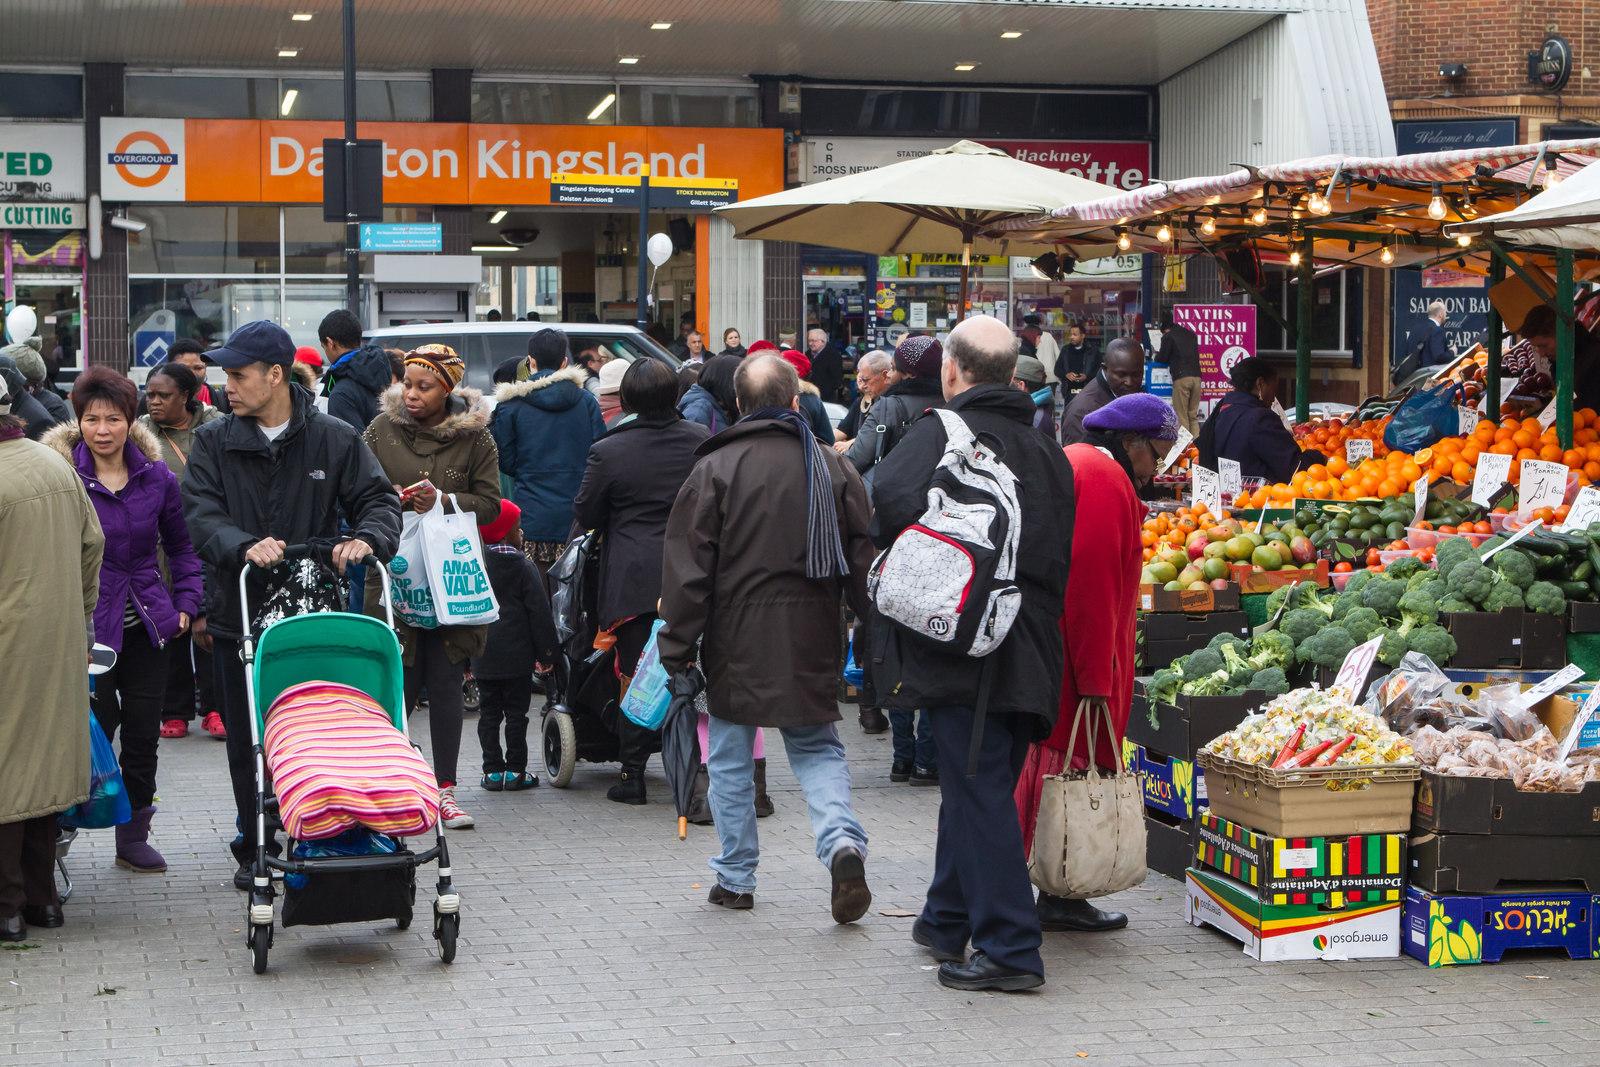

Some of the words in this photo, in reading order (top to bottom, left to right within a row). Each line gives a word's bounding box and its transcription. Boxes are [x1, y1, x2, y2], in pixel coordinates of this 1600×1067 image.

[1414, 130, 1460, 144] Welcome
[1463, 132, 1474, 143] to
[1475, 128, 1497, 143] all
[0, 152, 52, 176] ED
[113, 155, 173, 164] OVERGROUND
[270, 137, 459, 178] Daton
[478, 139, 706, 179] Kingsland
[1016, 149, 1092, 165] Hackney
[5, 206, 72, 225] CUTTING
[1409, 297, 1466, 313] SALON
[1177, 309, 1233, 320] MATHS
[1197, 334, 1244, 346] IENCE
[1231, 843, 1259, 865] Domaines
[1271, 878, 1341, 891] d'Aquitaine
[1341, 877, 1402, 888] Domaines
[1330, 931, 1389, 949] emergosol
